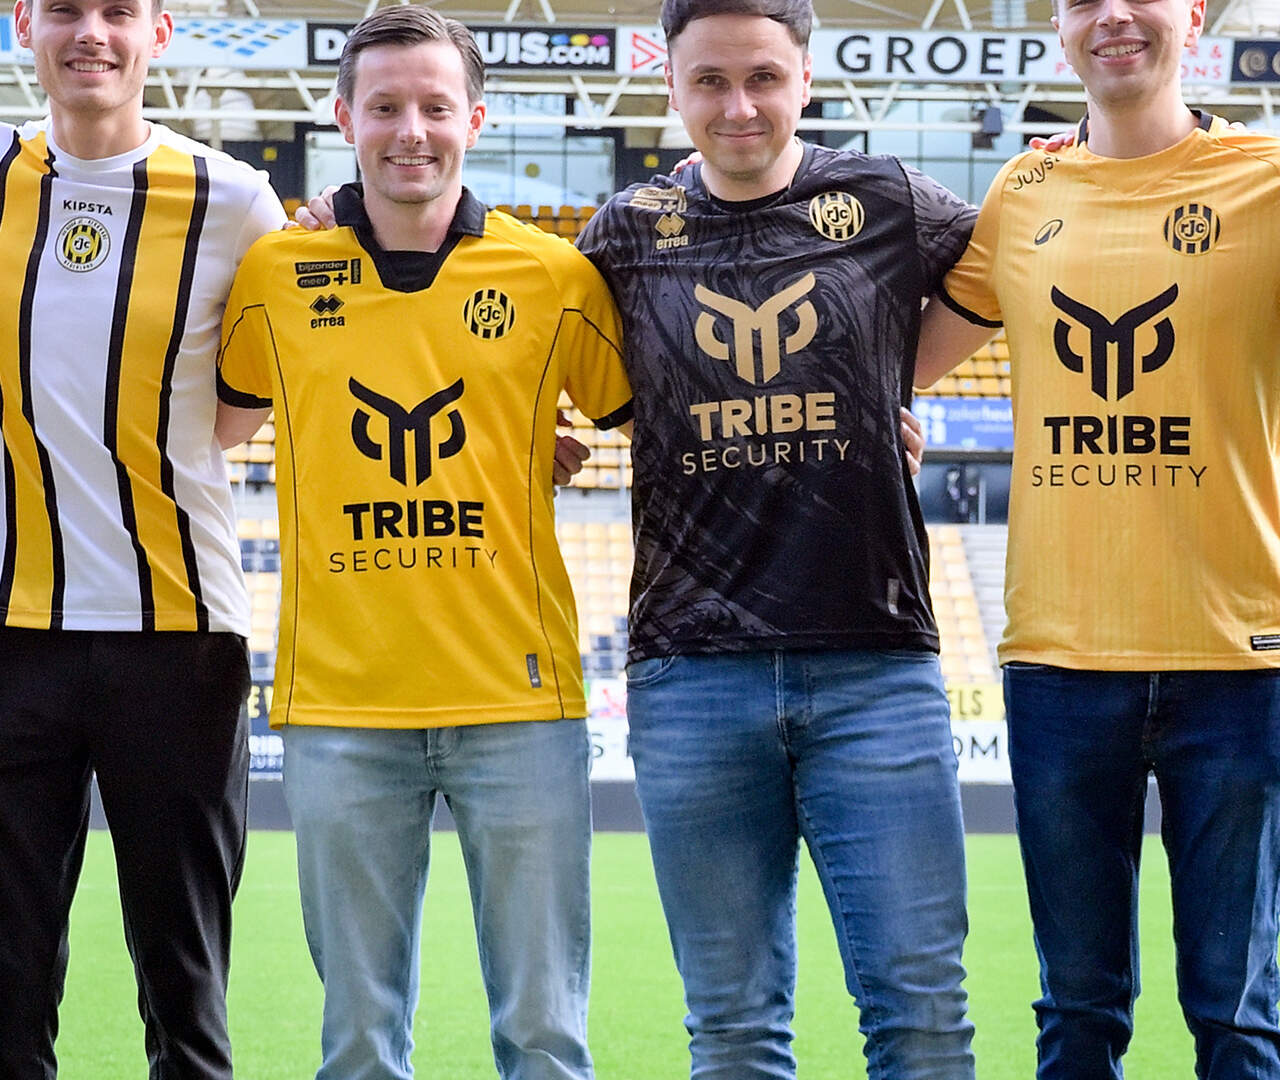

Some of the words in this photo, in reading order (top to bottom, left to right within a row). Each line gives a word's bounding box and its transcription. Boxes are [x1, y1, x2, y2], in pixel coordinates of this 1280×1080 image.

[835, 34, 1046, 76] GROEP
[63, 199, 113, 216] KIPSTA
[310, 316, 345, 328] errea
[689, 391, 837, 442] TRIBE
[1044, 414, 1191, 456] TRIBE
[681, 438, 852, 475] SECURITY
[1031, 464, 1208, 487] SECURITY
[343, 498, 485, 540] TRIBE
[329, 546, 499, 574] SECURITY
